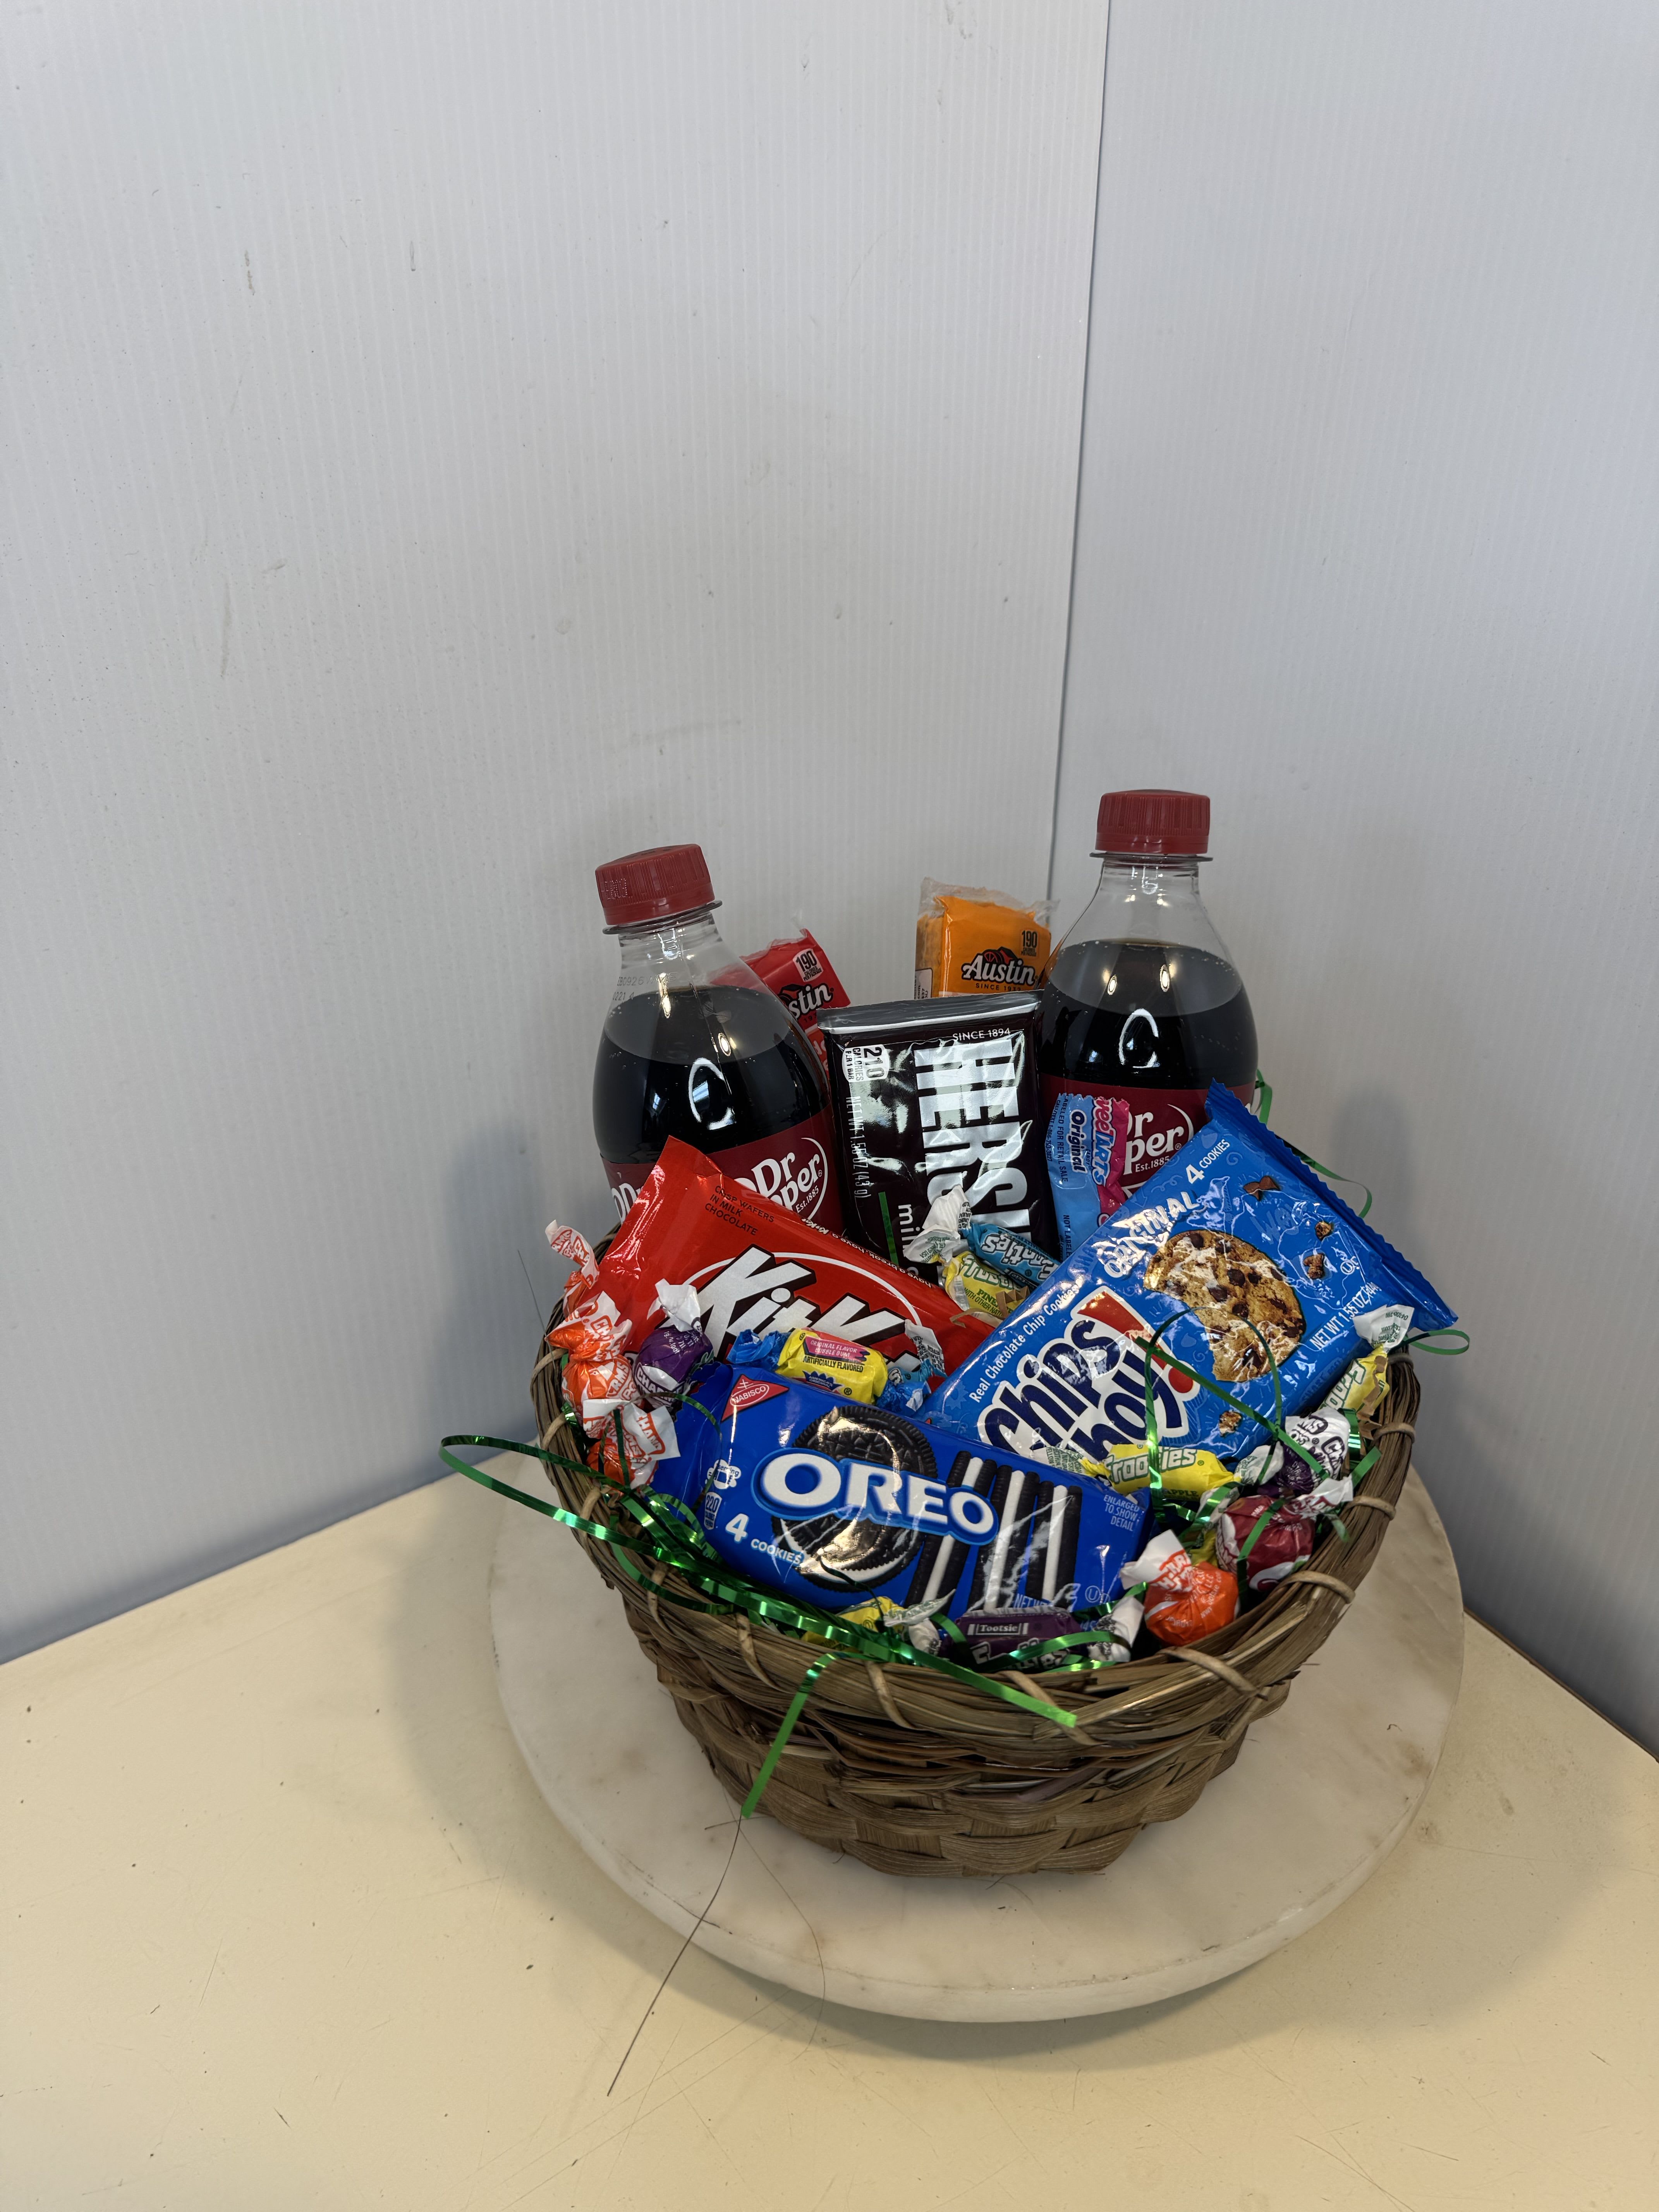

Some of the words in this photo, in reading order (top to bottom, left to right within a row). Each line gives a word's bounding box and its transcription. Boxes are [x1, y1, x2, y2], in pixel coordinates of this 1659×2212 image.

[1021, 930, 1038, 948] 190
[796, 951, 817, 971] 190
[963, 955, 1035, 985] Austin
[788, 983, 831, 1018] stin
[953, 1030, 984, 1042] SINCE
[988, 1027, 1011, 1037] 1894
[852, 1047, 864, 1081] CALORIES
[864, 1046, 885, 1080] 210
[847, 1066, 855, 1080] BAR
[846, 1096, 862, 1114] NET
[848, 1116, 864, 1131] WT
[1067, 1110, 1087, 1173] Original
[853, 1156, 869, 1170] OZ
[1186, 1164, 1204, 1184] 4
[1199, 1139, 1230, 1169] COOKIES
[751, 1152, 795, 1197] Dr
[1060, 1166, 1068, 1182] SALE
[710, 1194, 719, 1204] IN
[719, 1198, 743, 1216] MILK
[715, 1185, 738, 1204] CRISP
[740, 1200, 775, 1223] WAFERS
[704, 1203, 758, 1236] CHOCOLATE
[1064, 1229, 1072, 1259] LABELE
[907, 1270, 933, 1288] have
[974, 1296, 992, 1310] OTHER
[1309, 1328, 1331, 1350] NET
[1324, 1316, 1344, 1335] WT
[1338, 1302, 1359, 1322] 1.55
[811, 1340, 835, 1350] ORIGINAL
[836, 1345, 858, 1353] FLAVOR
[814, 1347, 837, 1356] BUBBLE
[803, 1356, 837, 1368] ARTIFICIALLY
[837, 1361, 864, 1373] FLAVORED
[970, 1380, 991, 1403] Real
[986, 1335, 1025, 1379] Chocolate
[1023, 1315, 1046, 1336] Chip
[733, 1385, 766, 1403] NABISCO
[1104, 1448, 1198, 1484] Frooies
[706, 1494, 720, 1510] 220
[763, 1453, 994, 1534] OREO
[1103, 1494, 1141, 1511] ENLARGED
[1105, 1504, 1116, 1513] TO
[1116, 1506, 1138, 1522] SHOW
[1111, 1516, 1134, 1531] DETAIL
[726, 1513, 749, 1542] 4
[751, 1539, 803, 1565] COOKIES
[981, 1624, 1018, 1633] Tootsie
